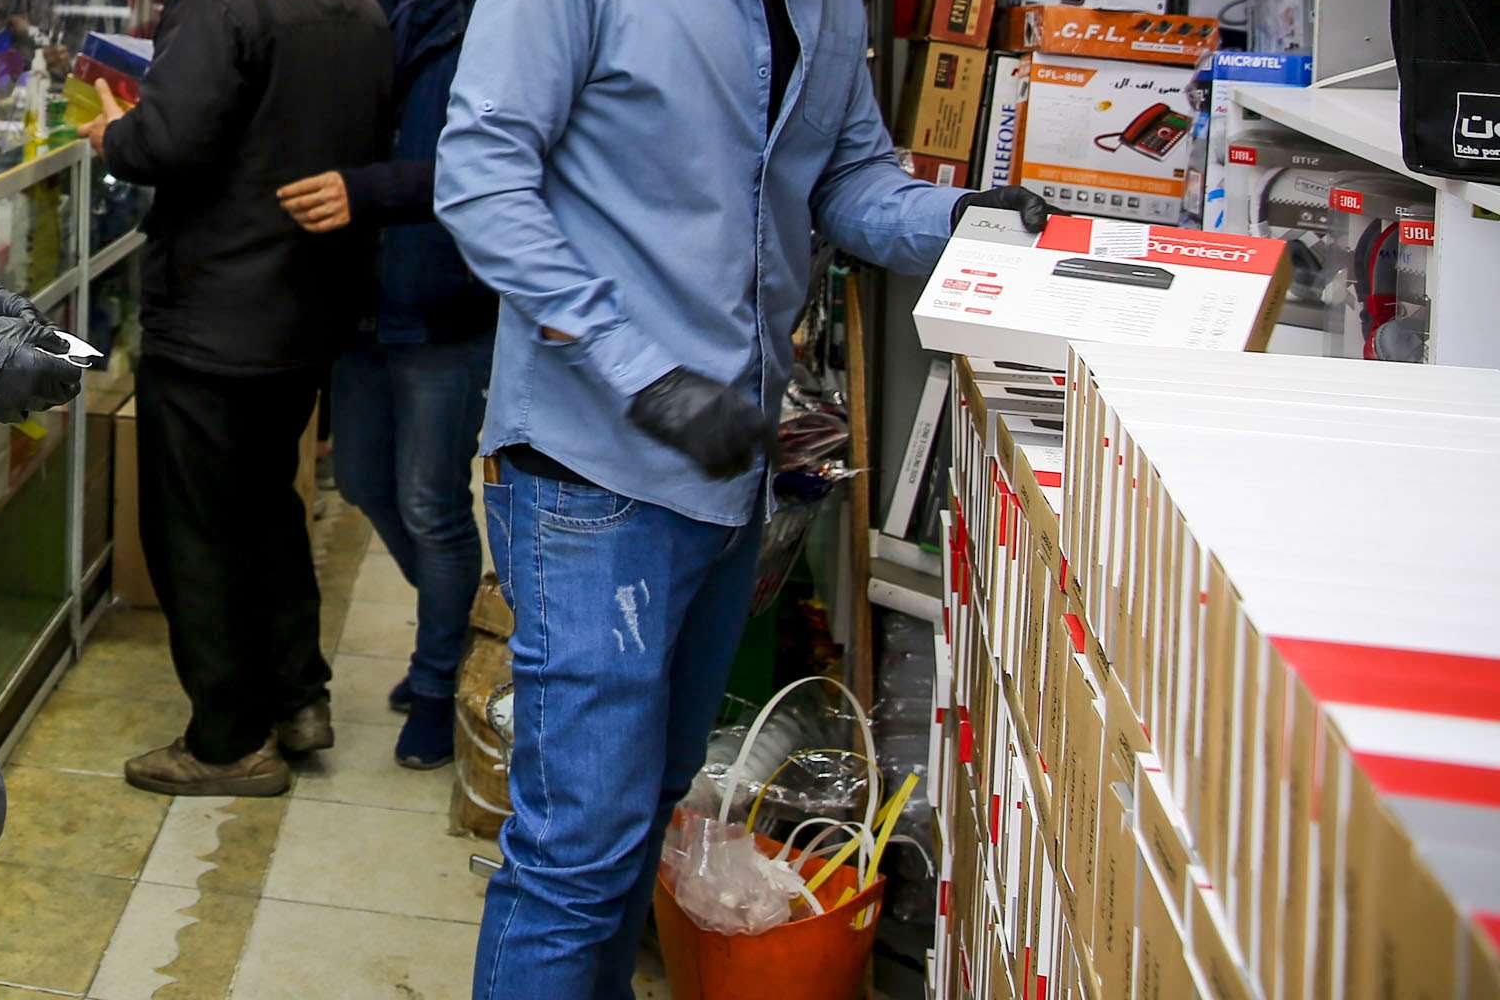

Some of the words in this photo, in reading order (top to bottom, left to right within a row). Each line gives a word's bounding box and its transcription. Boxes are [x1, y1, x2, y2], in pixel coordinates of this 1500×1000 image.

[1218, 55, 1282, 69] MICROTEL
[1231, 149, 1255, 162] JBL
[1456, 144, 1480, 155] Echo
[1482, 149, 1500, 159] por
[1339, 195, 1361, 210] JBL
[1403, 226, 1435, 241] JBL
